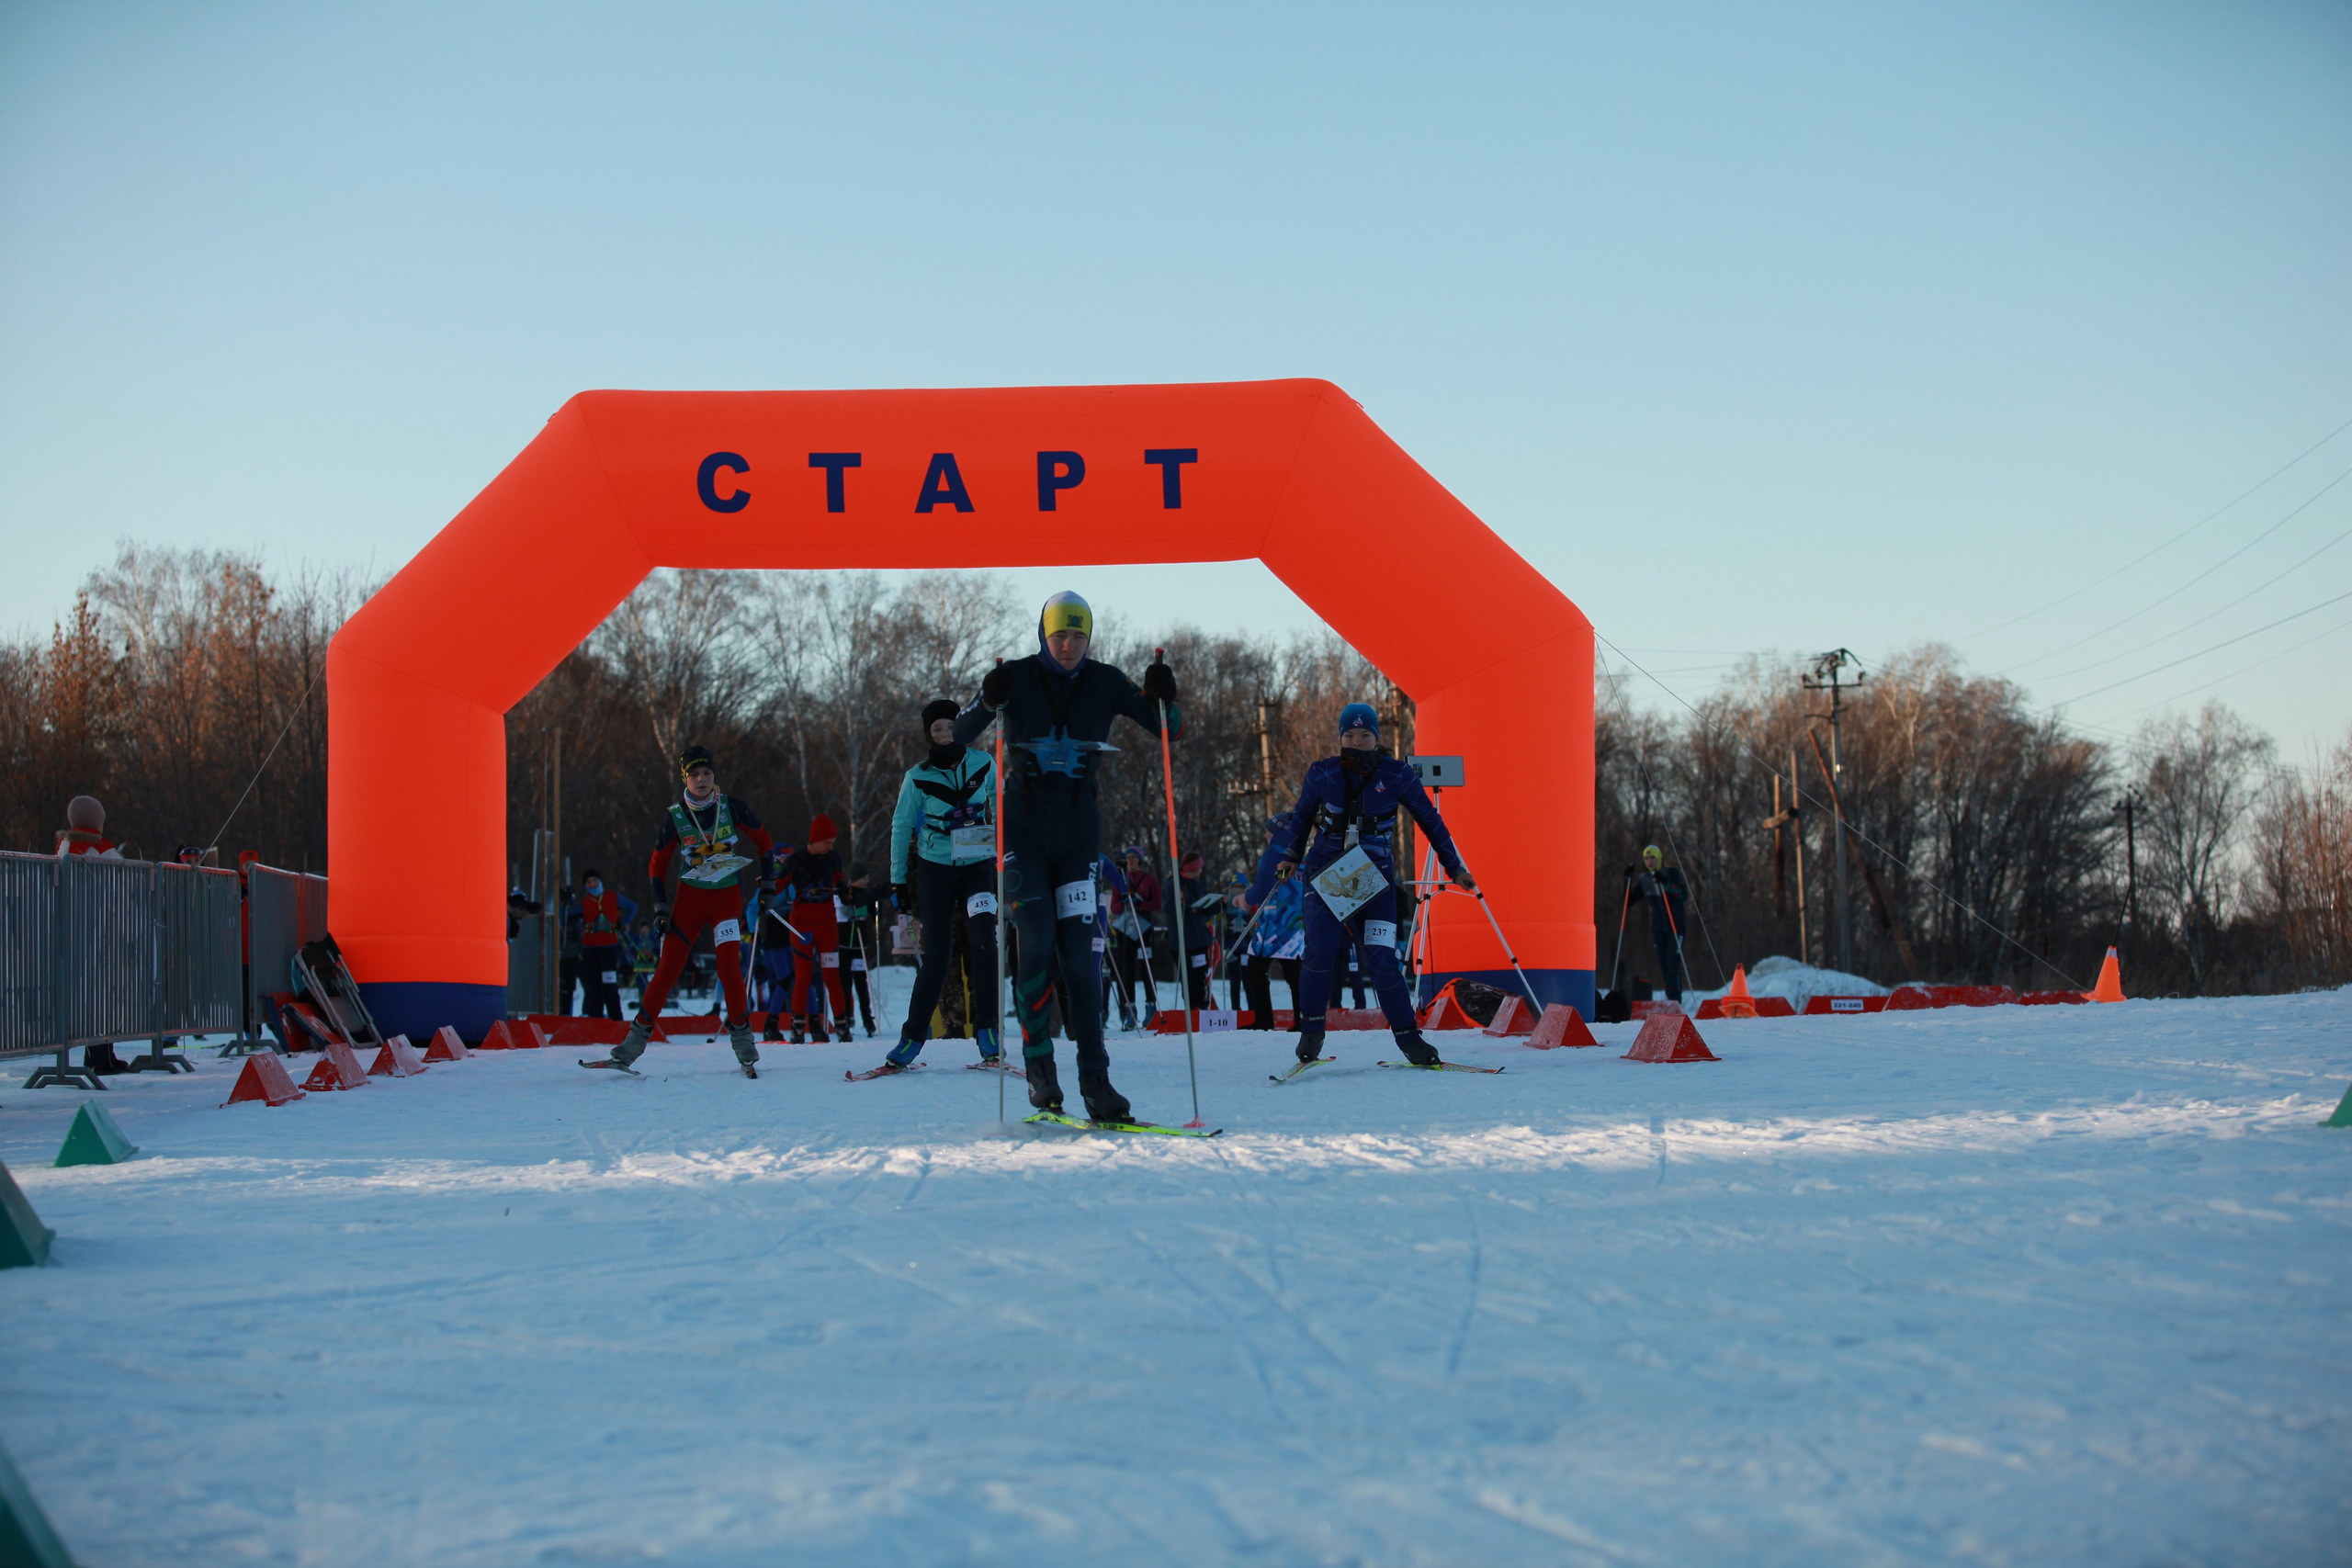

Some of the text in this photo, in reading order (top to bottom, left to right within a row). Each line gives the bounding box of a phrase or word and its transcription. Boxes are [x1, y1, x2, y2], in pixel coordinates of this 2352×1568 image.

[696, 448, 1198, 513] СТАРТ
[1069, 891, 1088, 903] 142
[975, 900, 989, 908] 435
[720, 928, 734, 938] 335
[1372, 928, 1387, 937] 237
[1209, 1019, 1228, 1027] 1-10
